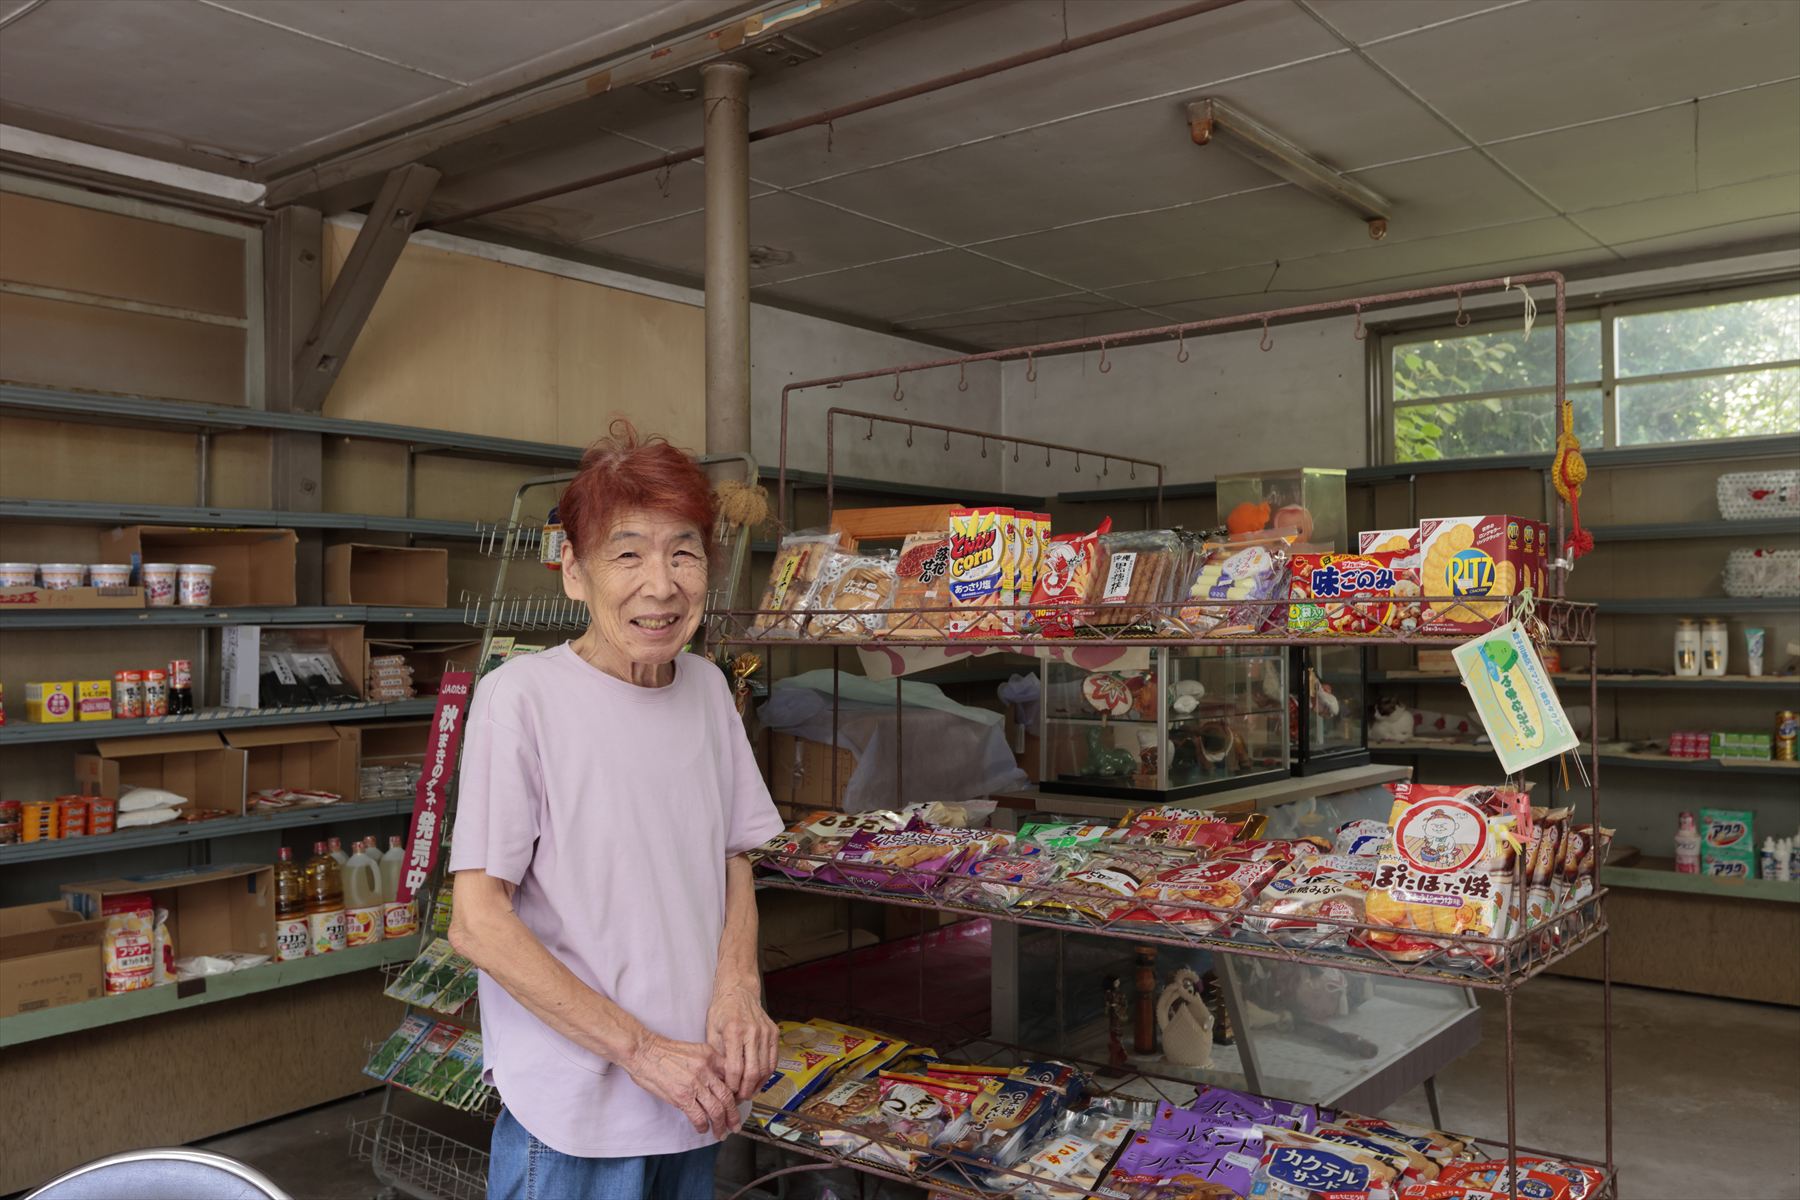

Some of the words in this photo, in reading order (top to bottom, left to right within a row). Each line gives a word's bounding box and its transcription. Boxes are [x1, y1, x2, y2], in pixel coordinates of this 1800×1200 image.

[951, 529, 997, 560] とんがり
[954, 580, 991, 594] あっさり塩
[1311, 566, 1397, 597] 味ごのみ
[1448, 557, 1493, 596] RITZ
[442, 684, 467, 694] JAのたね
[1376, 863, 1491, 898] ぽたぽた焼
[278, 934, 307, 945] タカラ
[120, 946, 150, 957] フラワー
[1282, 1149, 1359, 1185] カクテル
[1293, 1169, 1340, 1190] サンド
[1522, 1186, 1547, 1198] No.1
